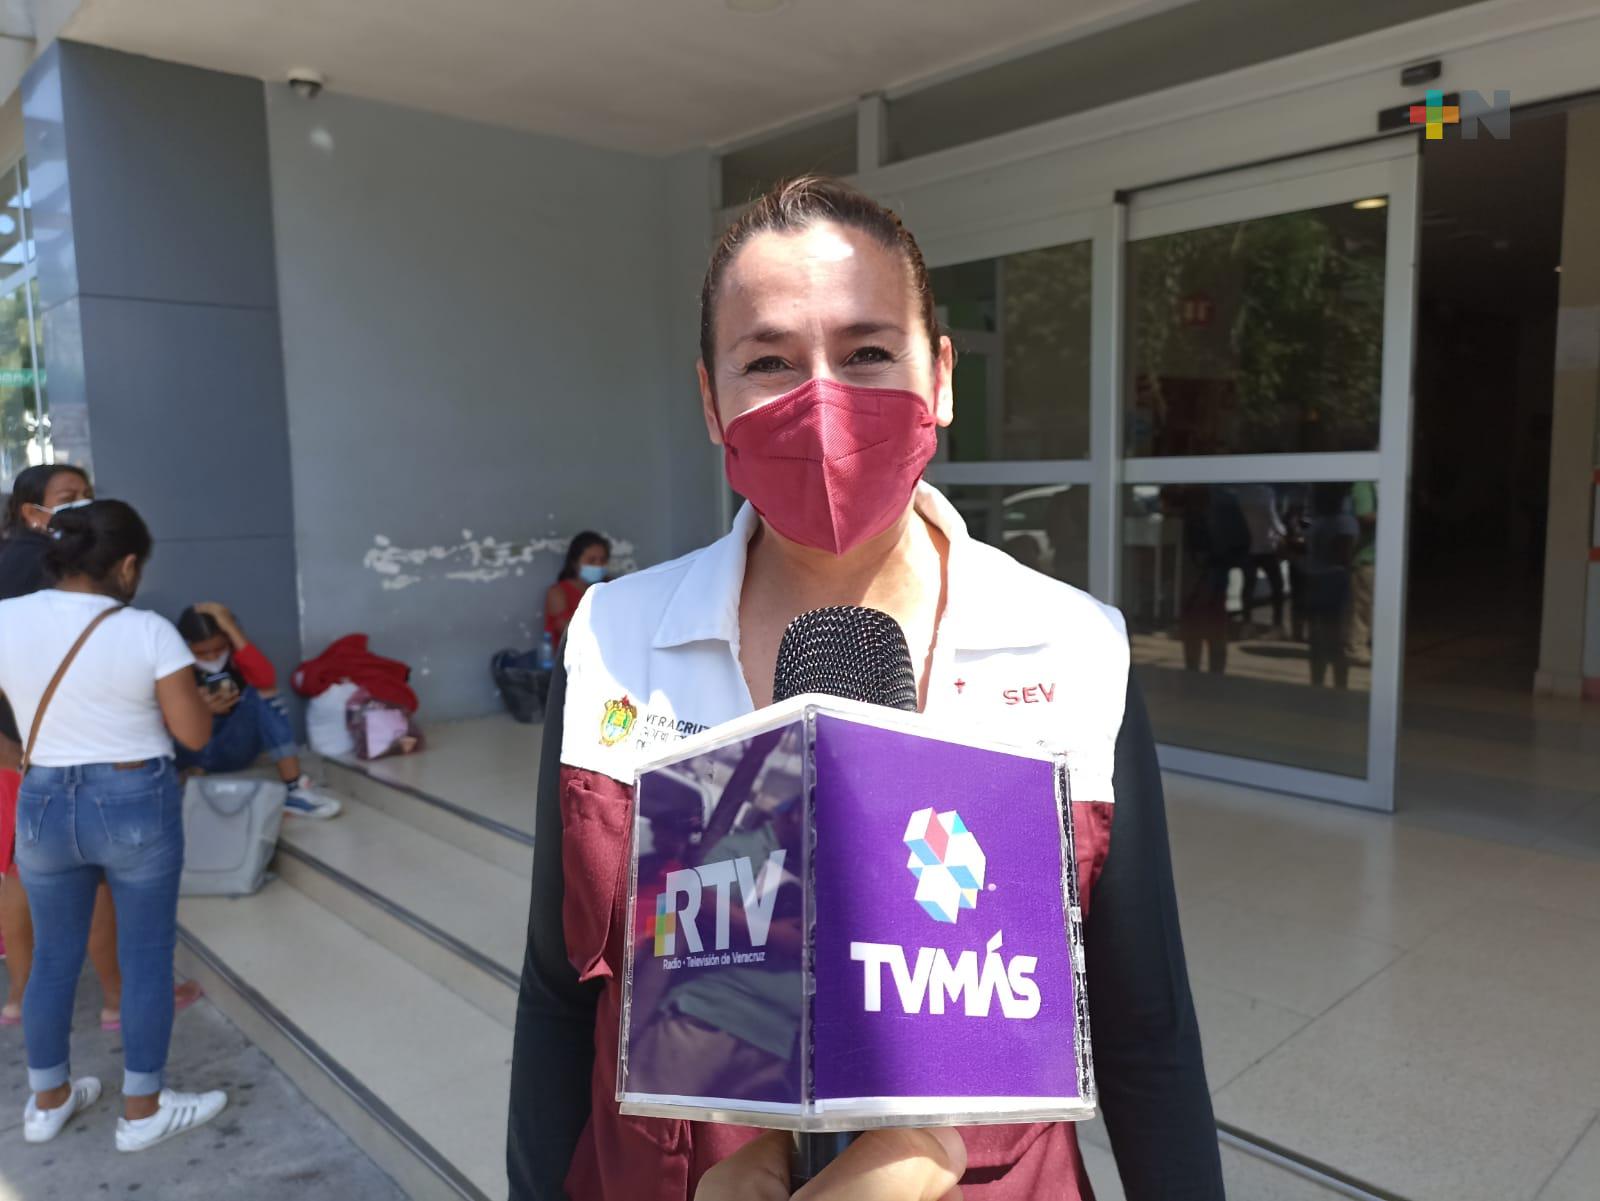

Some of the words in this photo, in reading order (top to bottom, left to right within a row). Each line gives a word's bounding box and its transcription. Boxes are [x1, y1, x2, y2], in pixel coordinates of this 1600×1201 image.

[1003, 682, 1055, 706] SEV
[664, 849, 787, 954] RTV
[663, 957, 682, 970] Radio
[686, 953, 720, 968] Televisión
[720, 952, 731, 965] de
[731, 951, 766, 964] Veracruz
[850, 929, 1042, 1020] TVMÁS
